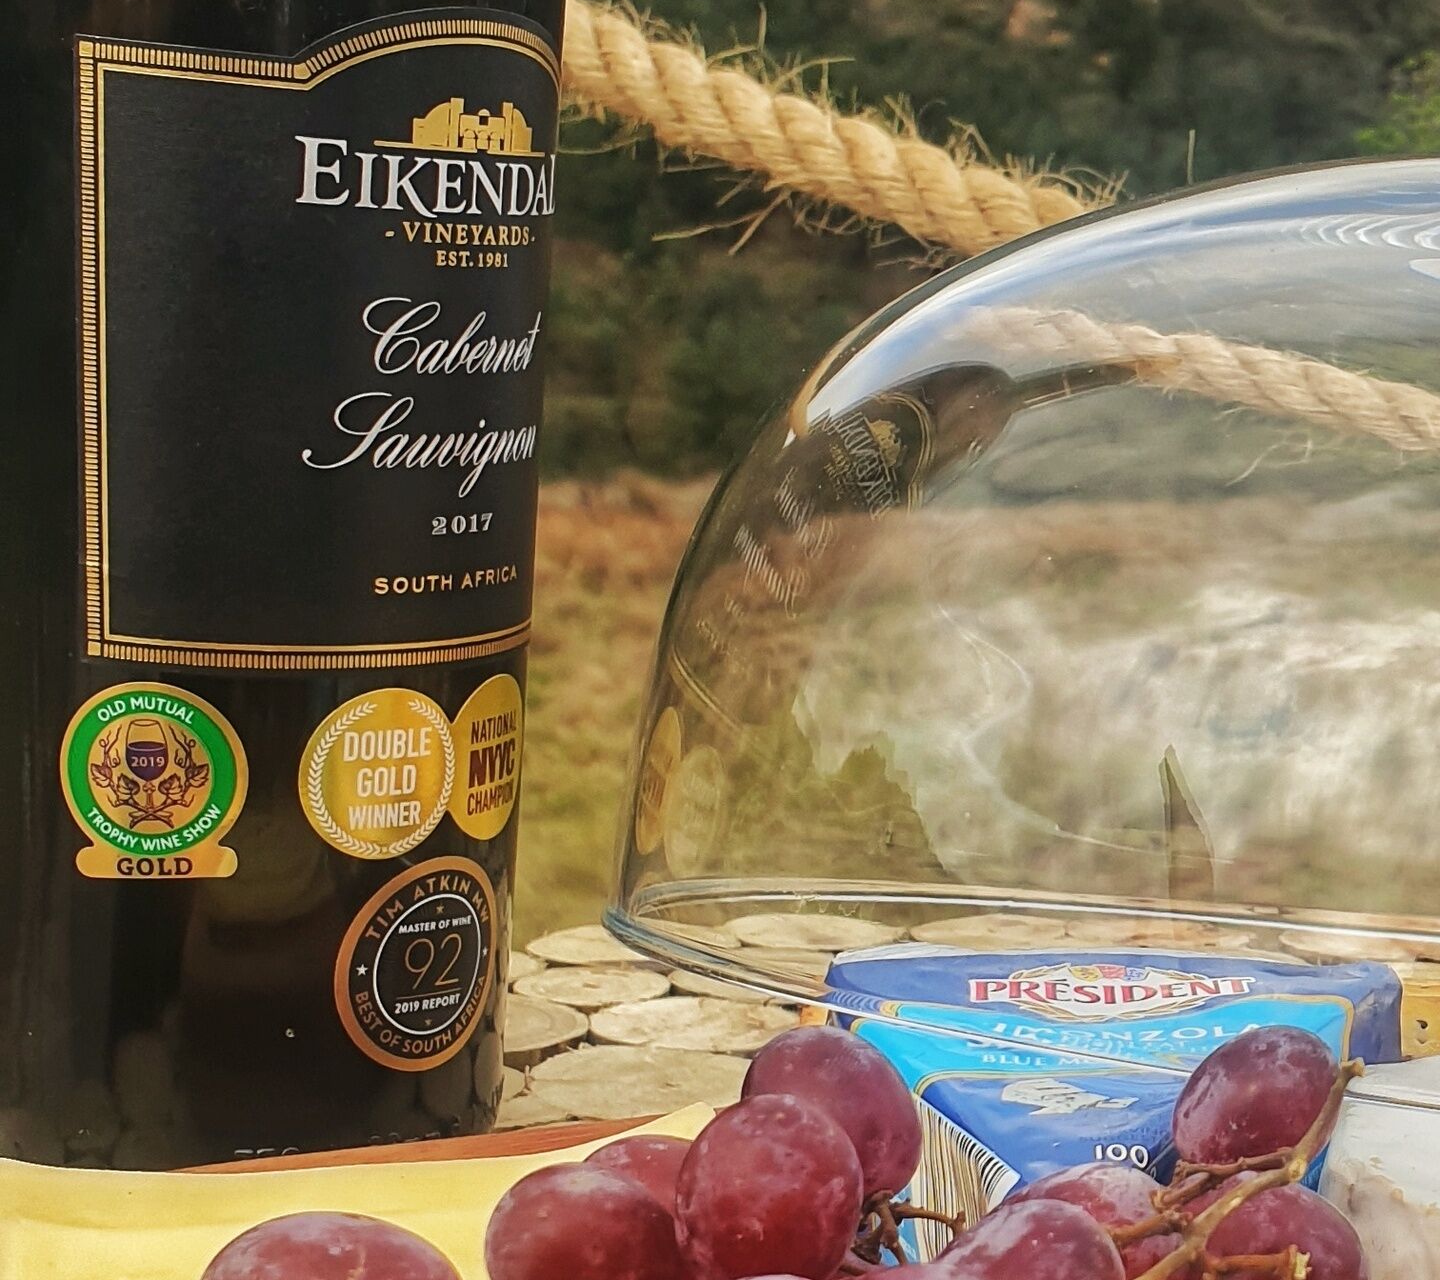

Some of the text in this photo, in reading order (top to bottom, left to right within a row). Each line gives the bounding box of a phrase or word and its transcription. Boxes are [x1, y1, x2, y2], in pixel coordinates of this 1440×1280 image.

[295, 135, 555, 218] EIKENDAL
[436, 250, 508, 268] EST. 1981
[362, 297, 541, 375] Cabernet
[302, 392, 537, 498] Sauvignon
[431, 513, 493, 535] 2017
[374, 565, 517, 595] SOUTH AFRICA
[97, 696, 194, 724] OLD MUTUAL
[471, 710, 517, 745] NATIONAL
[343, 726, 432, 762] DOUBLE
[131, 756, 166, 767] 2019
[357, 765, 417, 798] GOLD
[87, 804, 222, 852] TROPHY WINE SHOW
[348, 801, 421, 831] WINNER
[117, 857, 193, 876] GOLD
[365, 875, 489, 940] TIM ATKIN MW
[398, 915, 472, 934] MASTER OF WINE
[404, 933, 463, 990] 92
[394, 993, 460, 1014] 2019 REPORT
[973, 978, 1252, 1004] PRÉSIDENT
[355, 975, 486, 1054] BEST OF SOUTH AFRICA
[982, 1053, 1047, 1066] BLUE
[1095, 1144, 1149, 1169] 100
